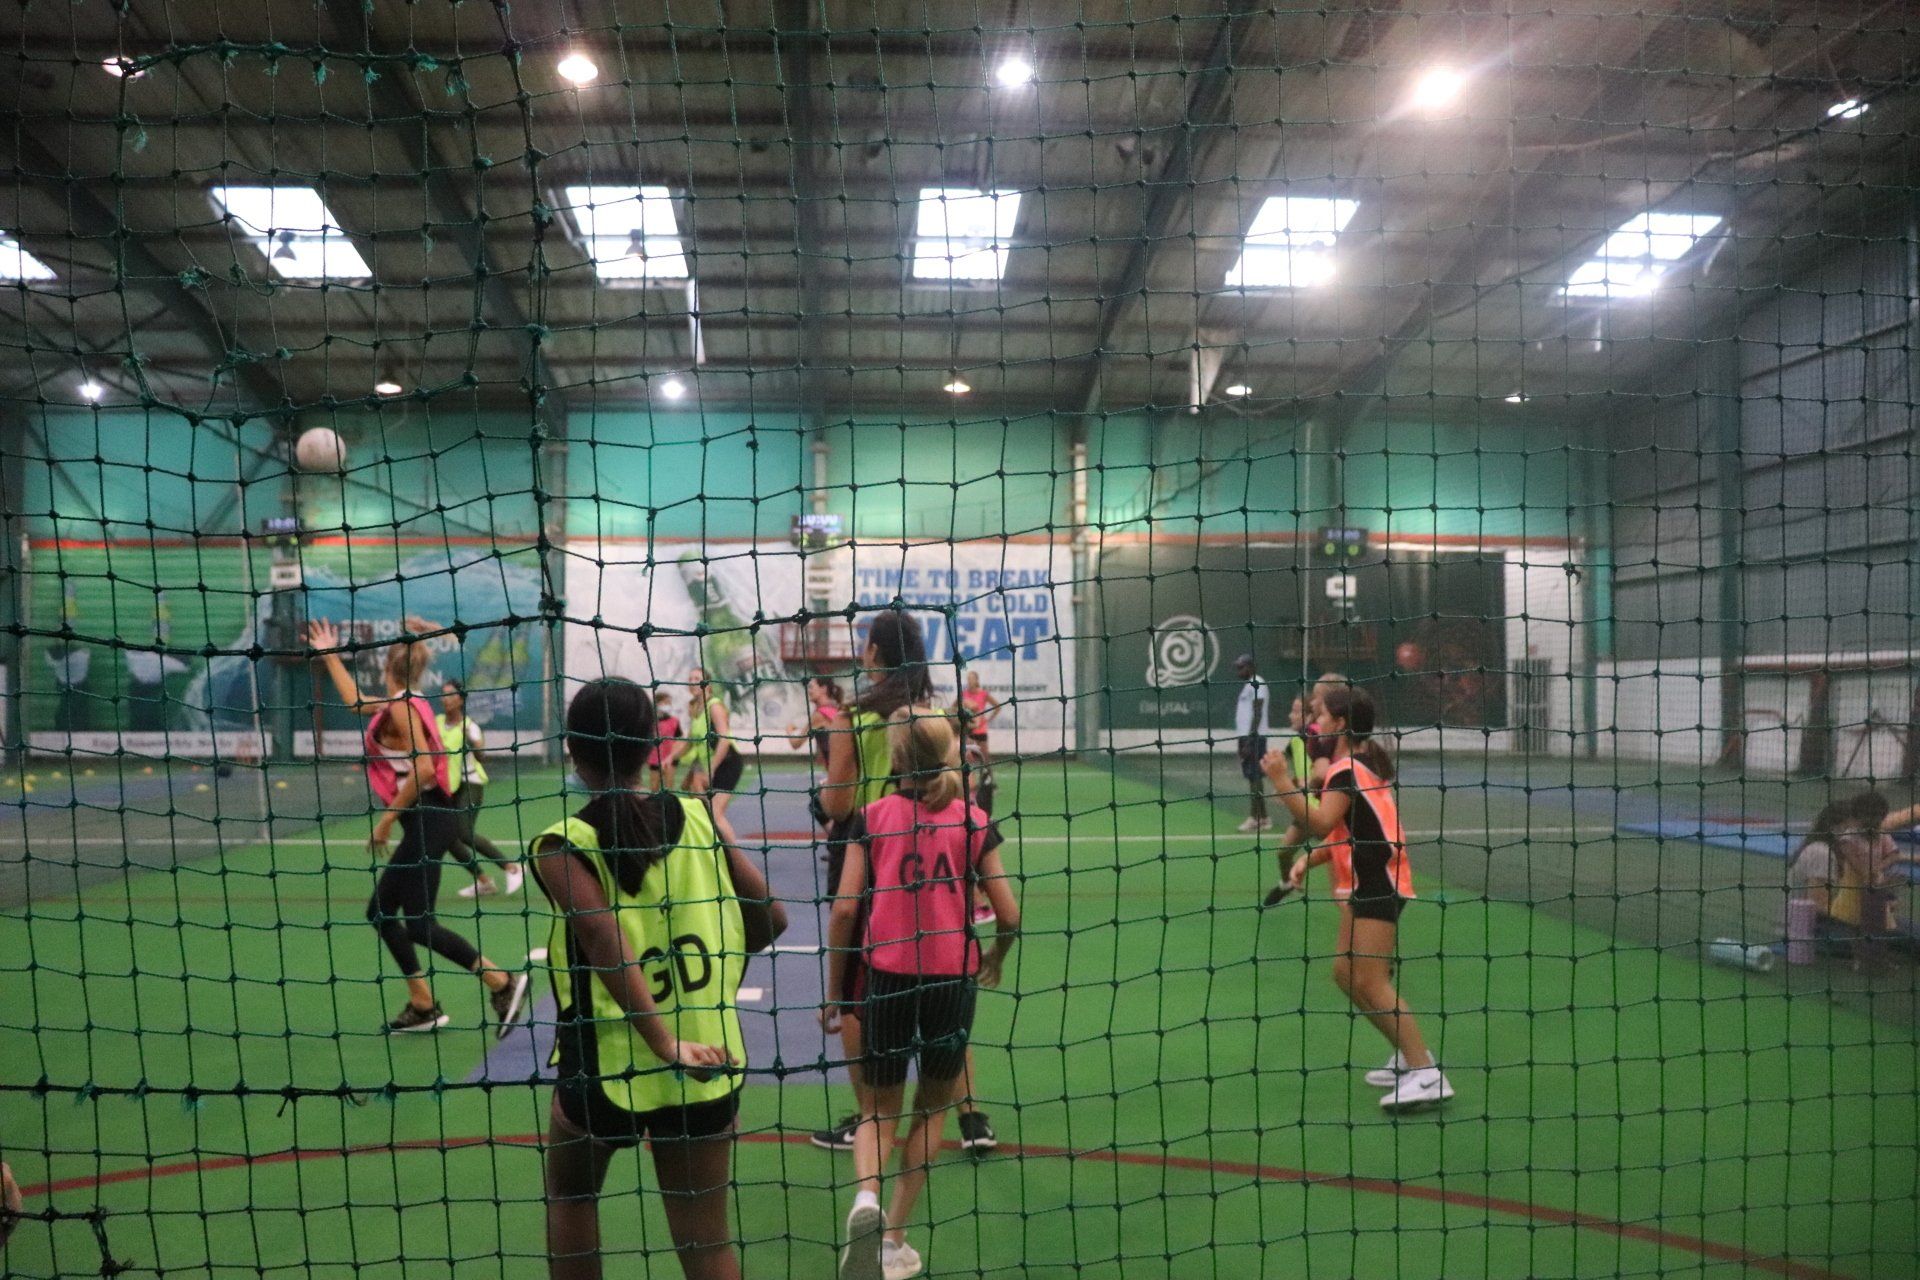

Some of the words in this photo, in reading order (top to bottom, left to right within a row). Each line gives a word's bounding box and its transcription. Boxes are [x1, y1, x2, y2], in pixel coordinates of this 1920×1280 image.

[857, 569, 918, 588] TIME
[928, 569, 959, 588] TO
[968, 569, 1048, 588] BREAK
[987, 594, 1047, 612] COLD
[899, 853, 957, 893] GA
[640, 934, 711, 1003] GD
